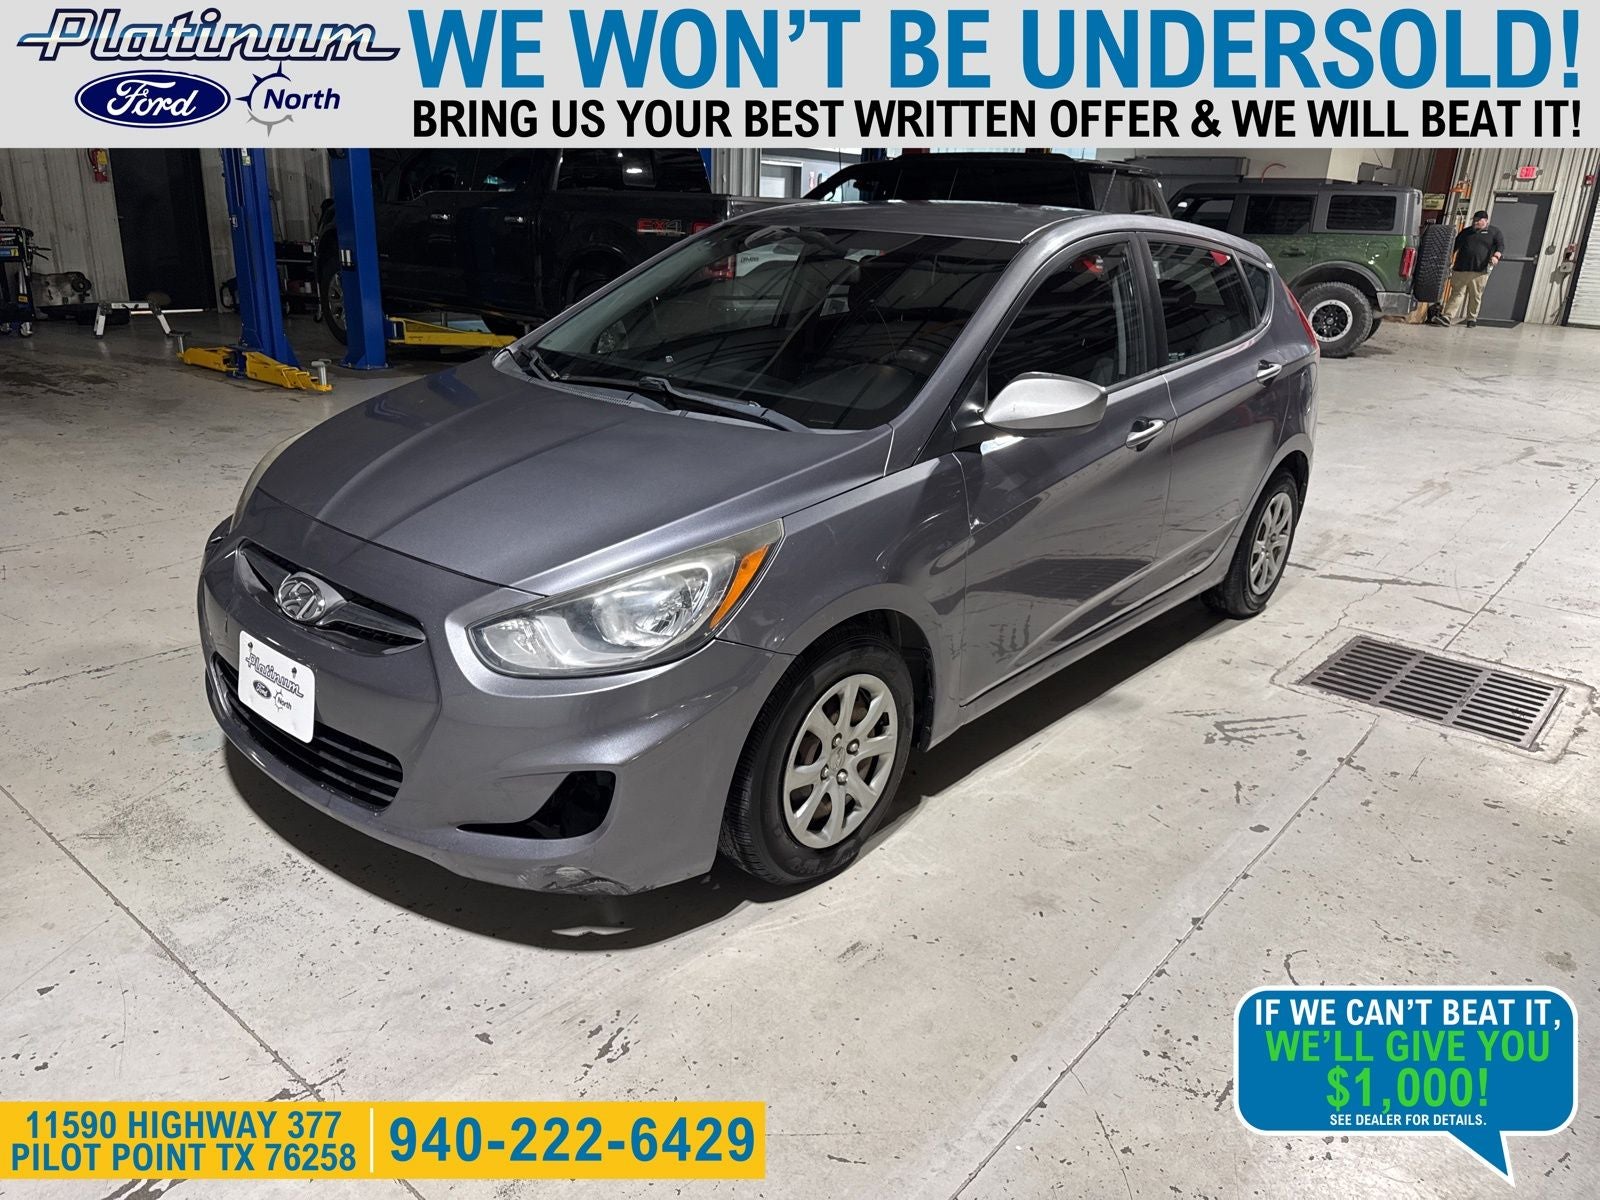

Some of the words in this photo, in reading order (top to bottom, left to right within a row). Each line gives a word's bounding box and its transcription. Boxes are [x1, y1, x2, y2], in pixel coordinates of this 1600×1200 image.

[636, 217, 682, 234] FX4
[245, 653, 304, 698] Platinum
[277, 696, 292, 711] North
